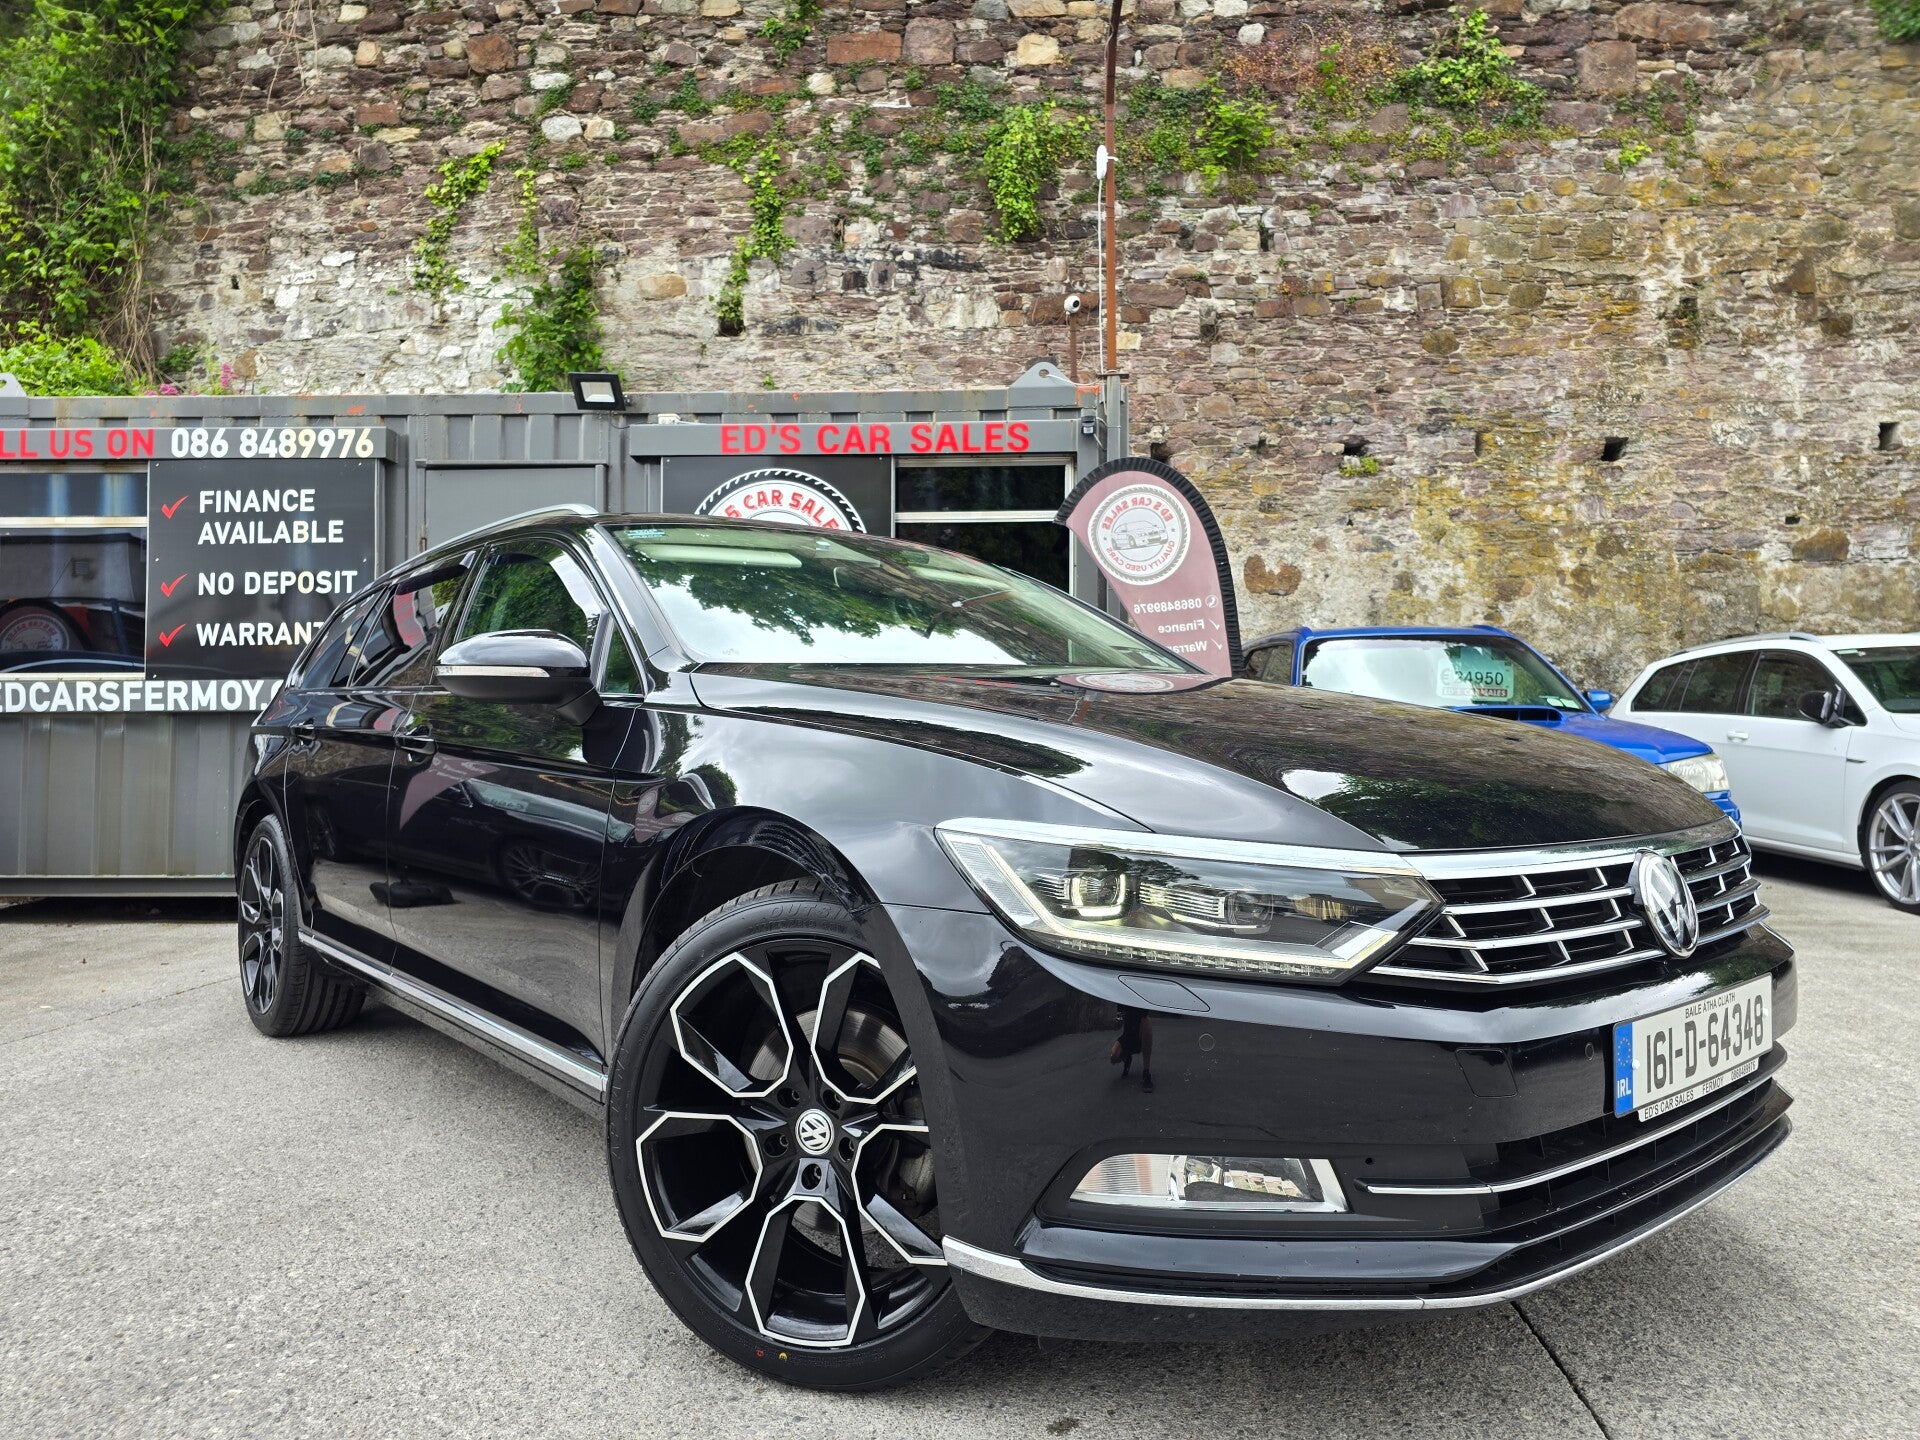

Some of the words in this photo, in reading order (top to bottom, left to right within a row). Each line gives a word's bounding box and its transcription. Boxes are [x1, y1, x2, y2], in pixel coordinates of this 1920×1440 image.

[50, 429, 94, 458] US
[107, 428, 154, 457] ON
[171, 428, 228, 458] 086
[240, 428, 374, 458] 8489976
[720, 424, 801, 454] ED'S
[817, 423, 891, 454] CAR
[910, 422, 1030, 453] SALES
[199, 489, 315, 514] FINANCE
[743, 489, 784, 510] CAR
[198, 520, 344, 545] AVAILABLE
[198, 572, 234, 596] NO
[244, 570, 358, 596] DEPOSIT
[0, 680, 284, 713] DCARSFERMOY.
[1685, 1003, 1702, 1019] BAILE
[1646, 995, 1763, 1094] 161-D-64348
[1617, 1078, 1631, 1099] IRL
[1644, 1104, 1659, 1119] ED'S
[1660, 1099, 1674, 1113] CAR
[1675, 1089, 1695, 1108] SALES
[1702, 1076, 1725, 1094] FERMOY
